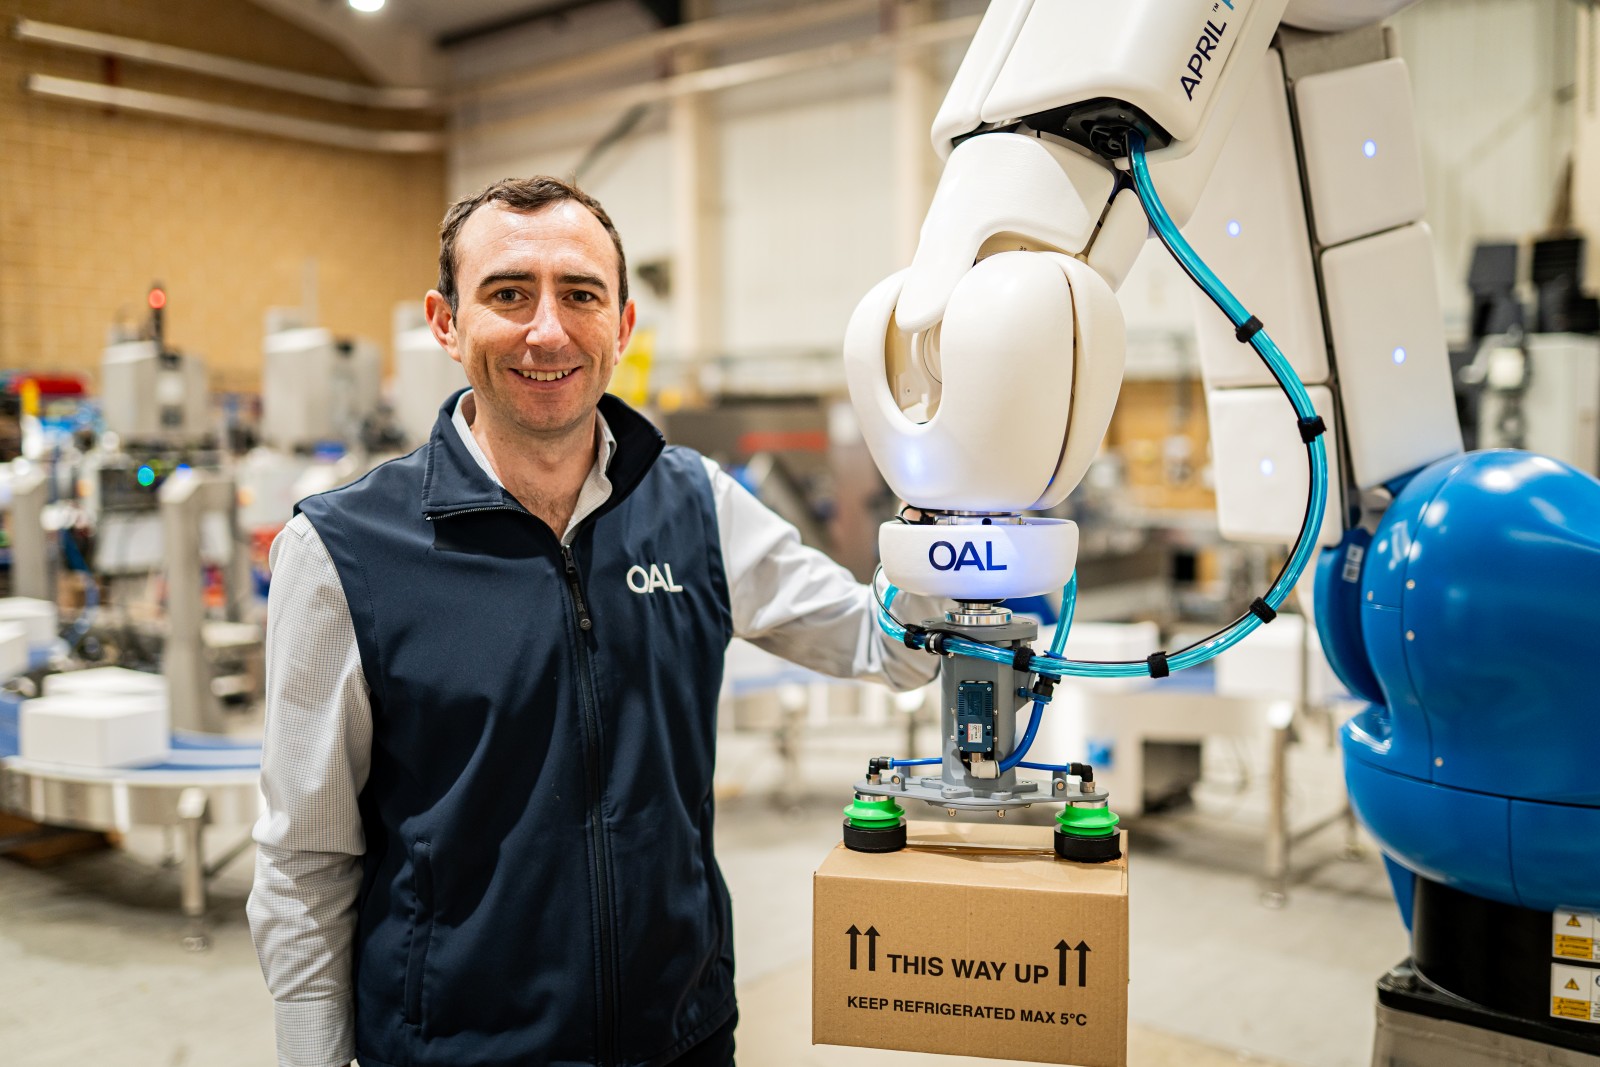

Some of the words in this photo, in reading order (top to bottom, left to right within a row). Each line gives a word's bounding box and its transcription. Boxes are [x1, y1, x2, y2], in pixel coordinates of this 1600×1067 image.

[1180, 20, 1227, 101] APRIL
[929, 541, 1007, 571] OAL
[626, 563, 683, 593] OAL
[887, 954, 944, 976] THIS
[951, 959, 1007, 981] WAY
[1014, 964, 1049, 984] UP
[847, 996, 889, 1010] KEEP
[893, 999, 1015, 1020] REFRIGERATED
[1020, 1010, 1055, 1024] MAX
[1059, 1013, 1087, 1026] 5°C
